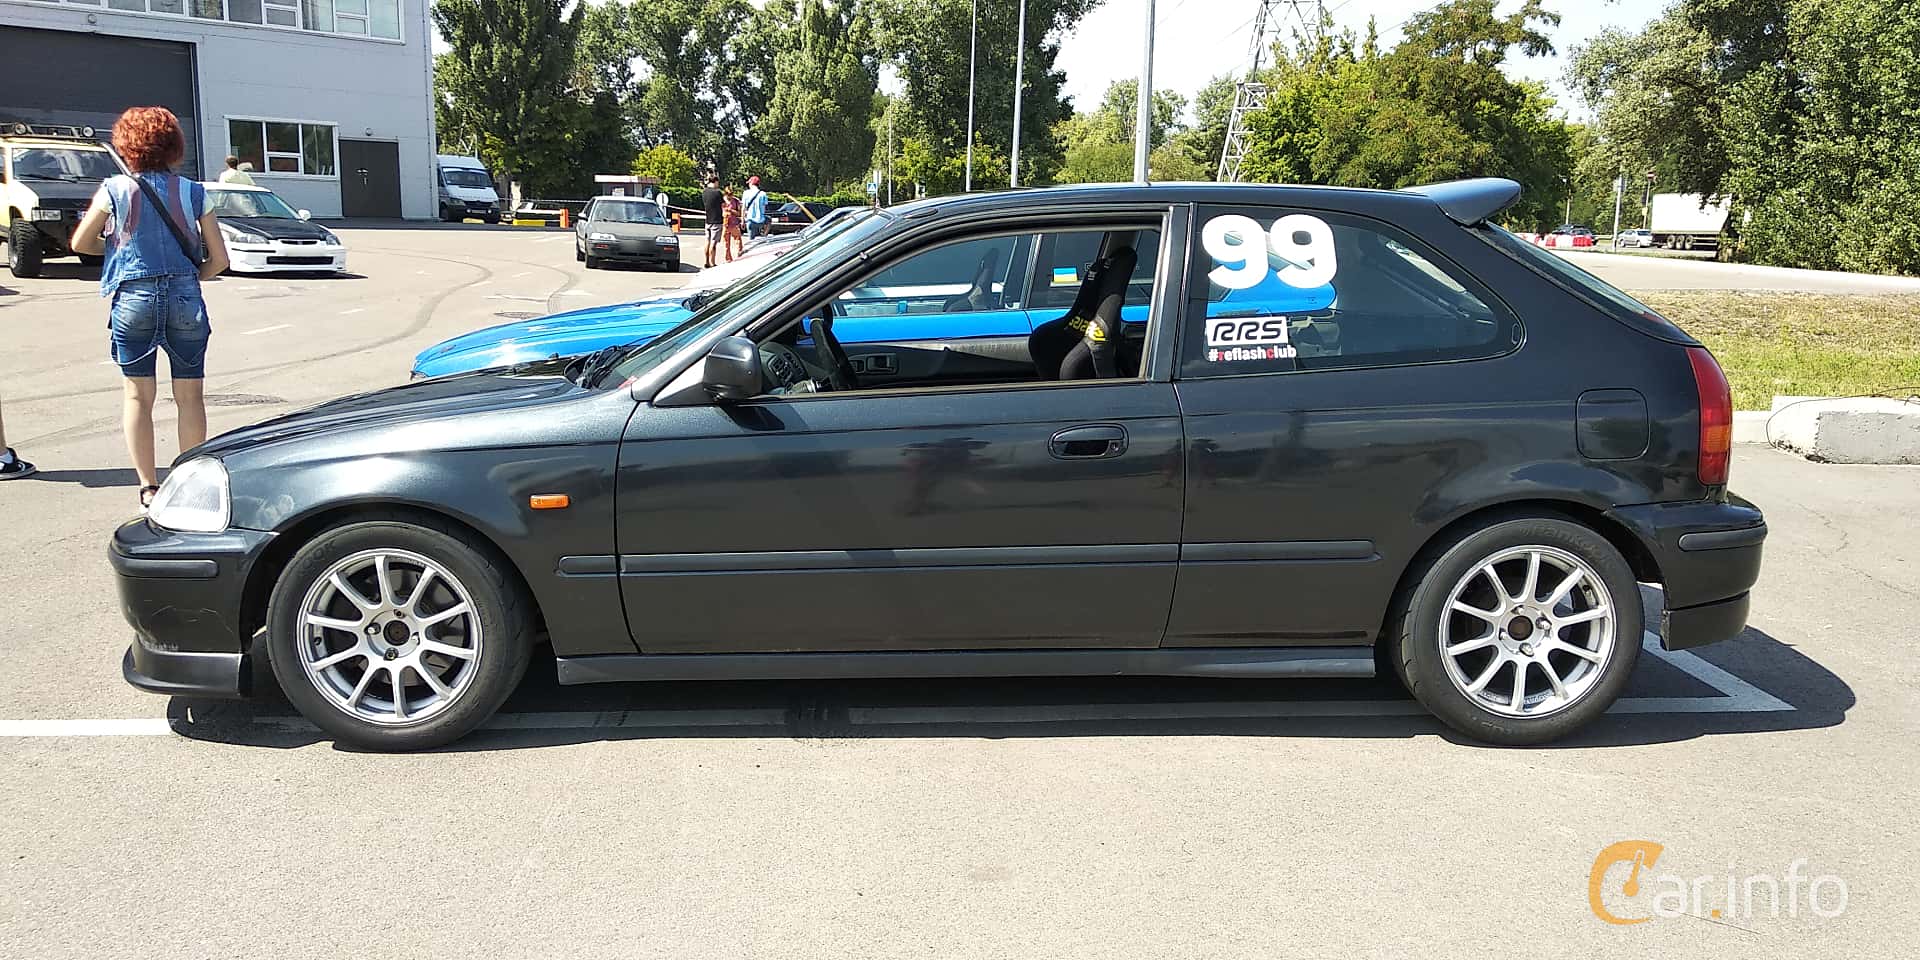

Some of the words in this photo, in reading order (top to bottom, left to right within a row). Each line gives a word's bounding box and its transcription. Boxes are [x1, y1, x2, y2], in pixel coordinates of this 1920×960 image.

[1202, 214, 1337, 289] 99
[1212, 320, 1282, 341] RRS
[1208, 344, 1297, 362] #reflashclub
